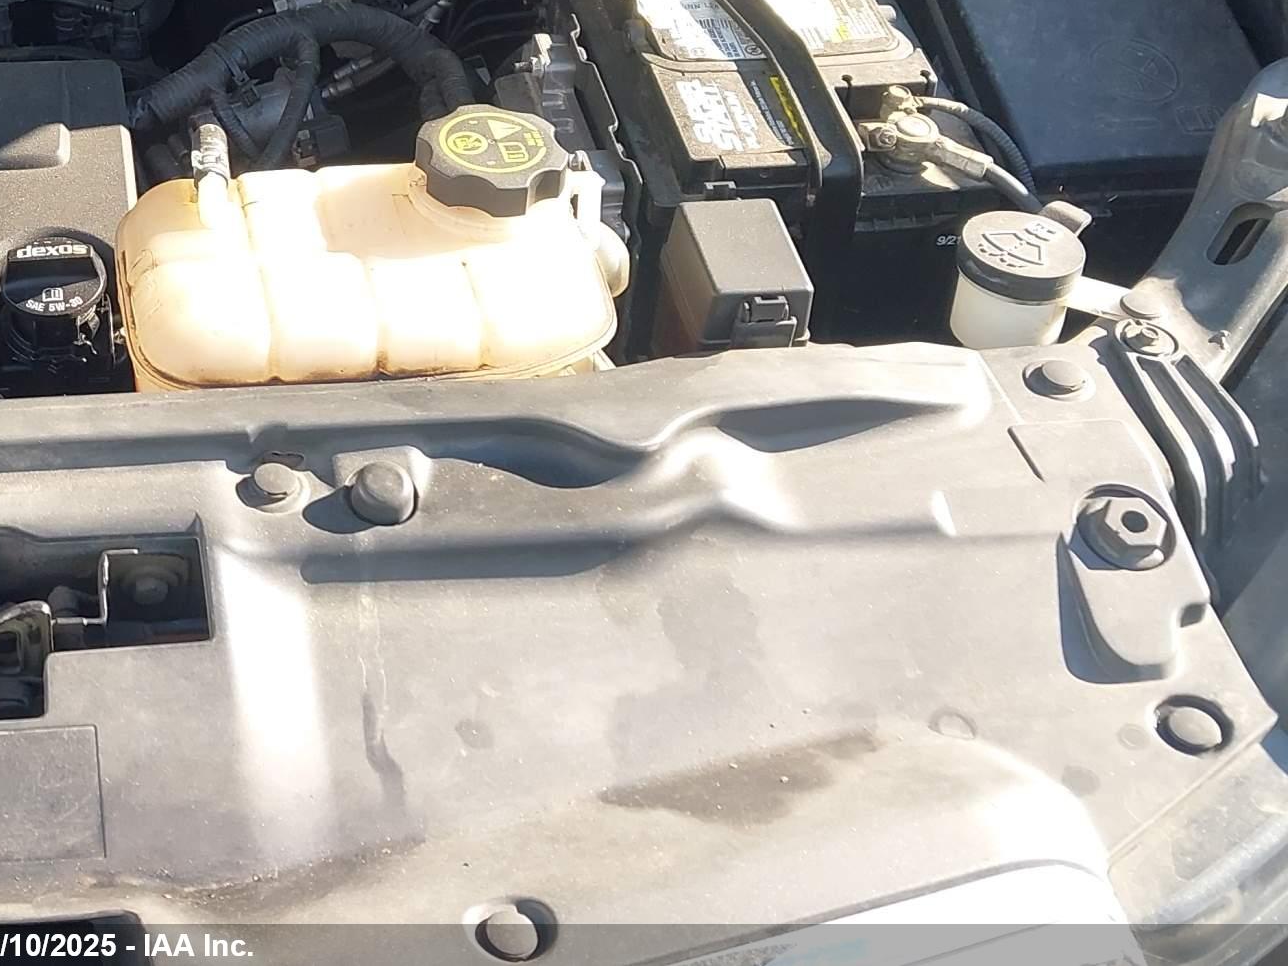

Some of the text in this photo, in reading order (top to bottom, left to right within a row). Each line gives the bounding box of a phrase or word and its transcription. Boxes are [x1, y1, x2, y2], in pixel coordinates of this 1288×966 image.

[16, 243, 89, 259] dexos
[25, 296, 84, 312] SAE 5W-30
